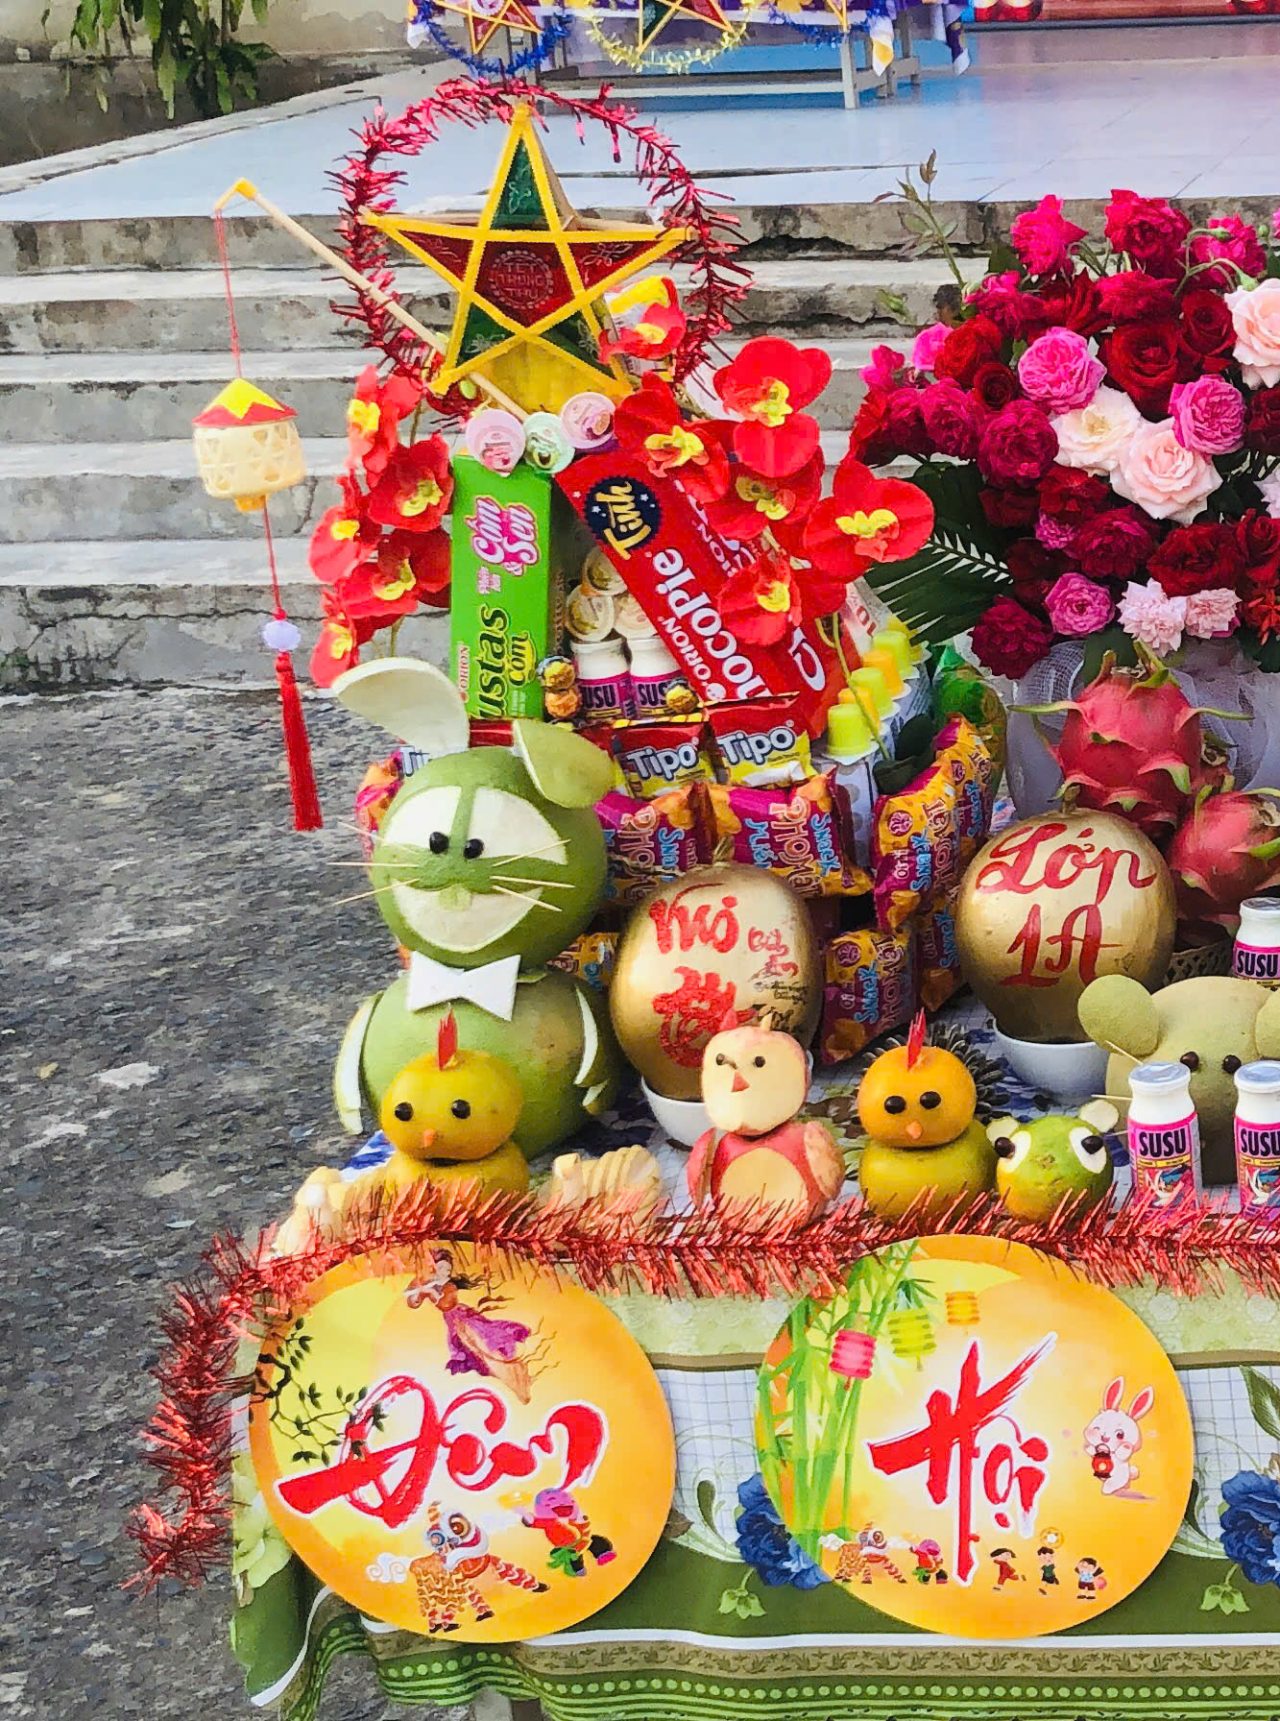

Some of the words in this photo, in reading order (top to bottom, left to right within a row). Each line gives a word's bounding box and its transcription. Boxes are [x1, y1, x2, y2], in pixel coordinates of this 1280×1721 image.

[477, 603, 509, 718] ustas
[660, 618, 712, 681] ORION
[578, 685, 615, 709] USU
[638, 683, 671, 706] SUS
[627, 743, 700, 780] Tipo
[718, 726, 797, 765] Tipo
[976, 822, 1158, 898] Lớp
[1002, 903, 1124, 988] 1A
[1237, 950, 1279, 977] SUSU
[1139, 1128, 1187, 1157] SUSU
[277, 1375, 605, 1529] Đêm
[868, 1332, 1057, 1584] Hội
